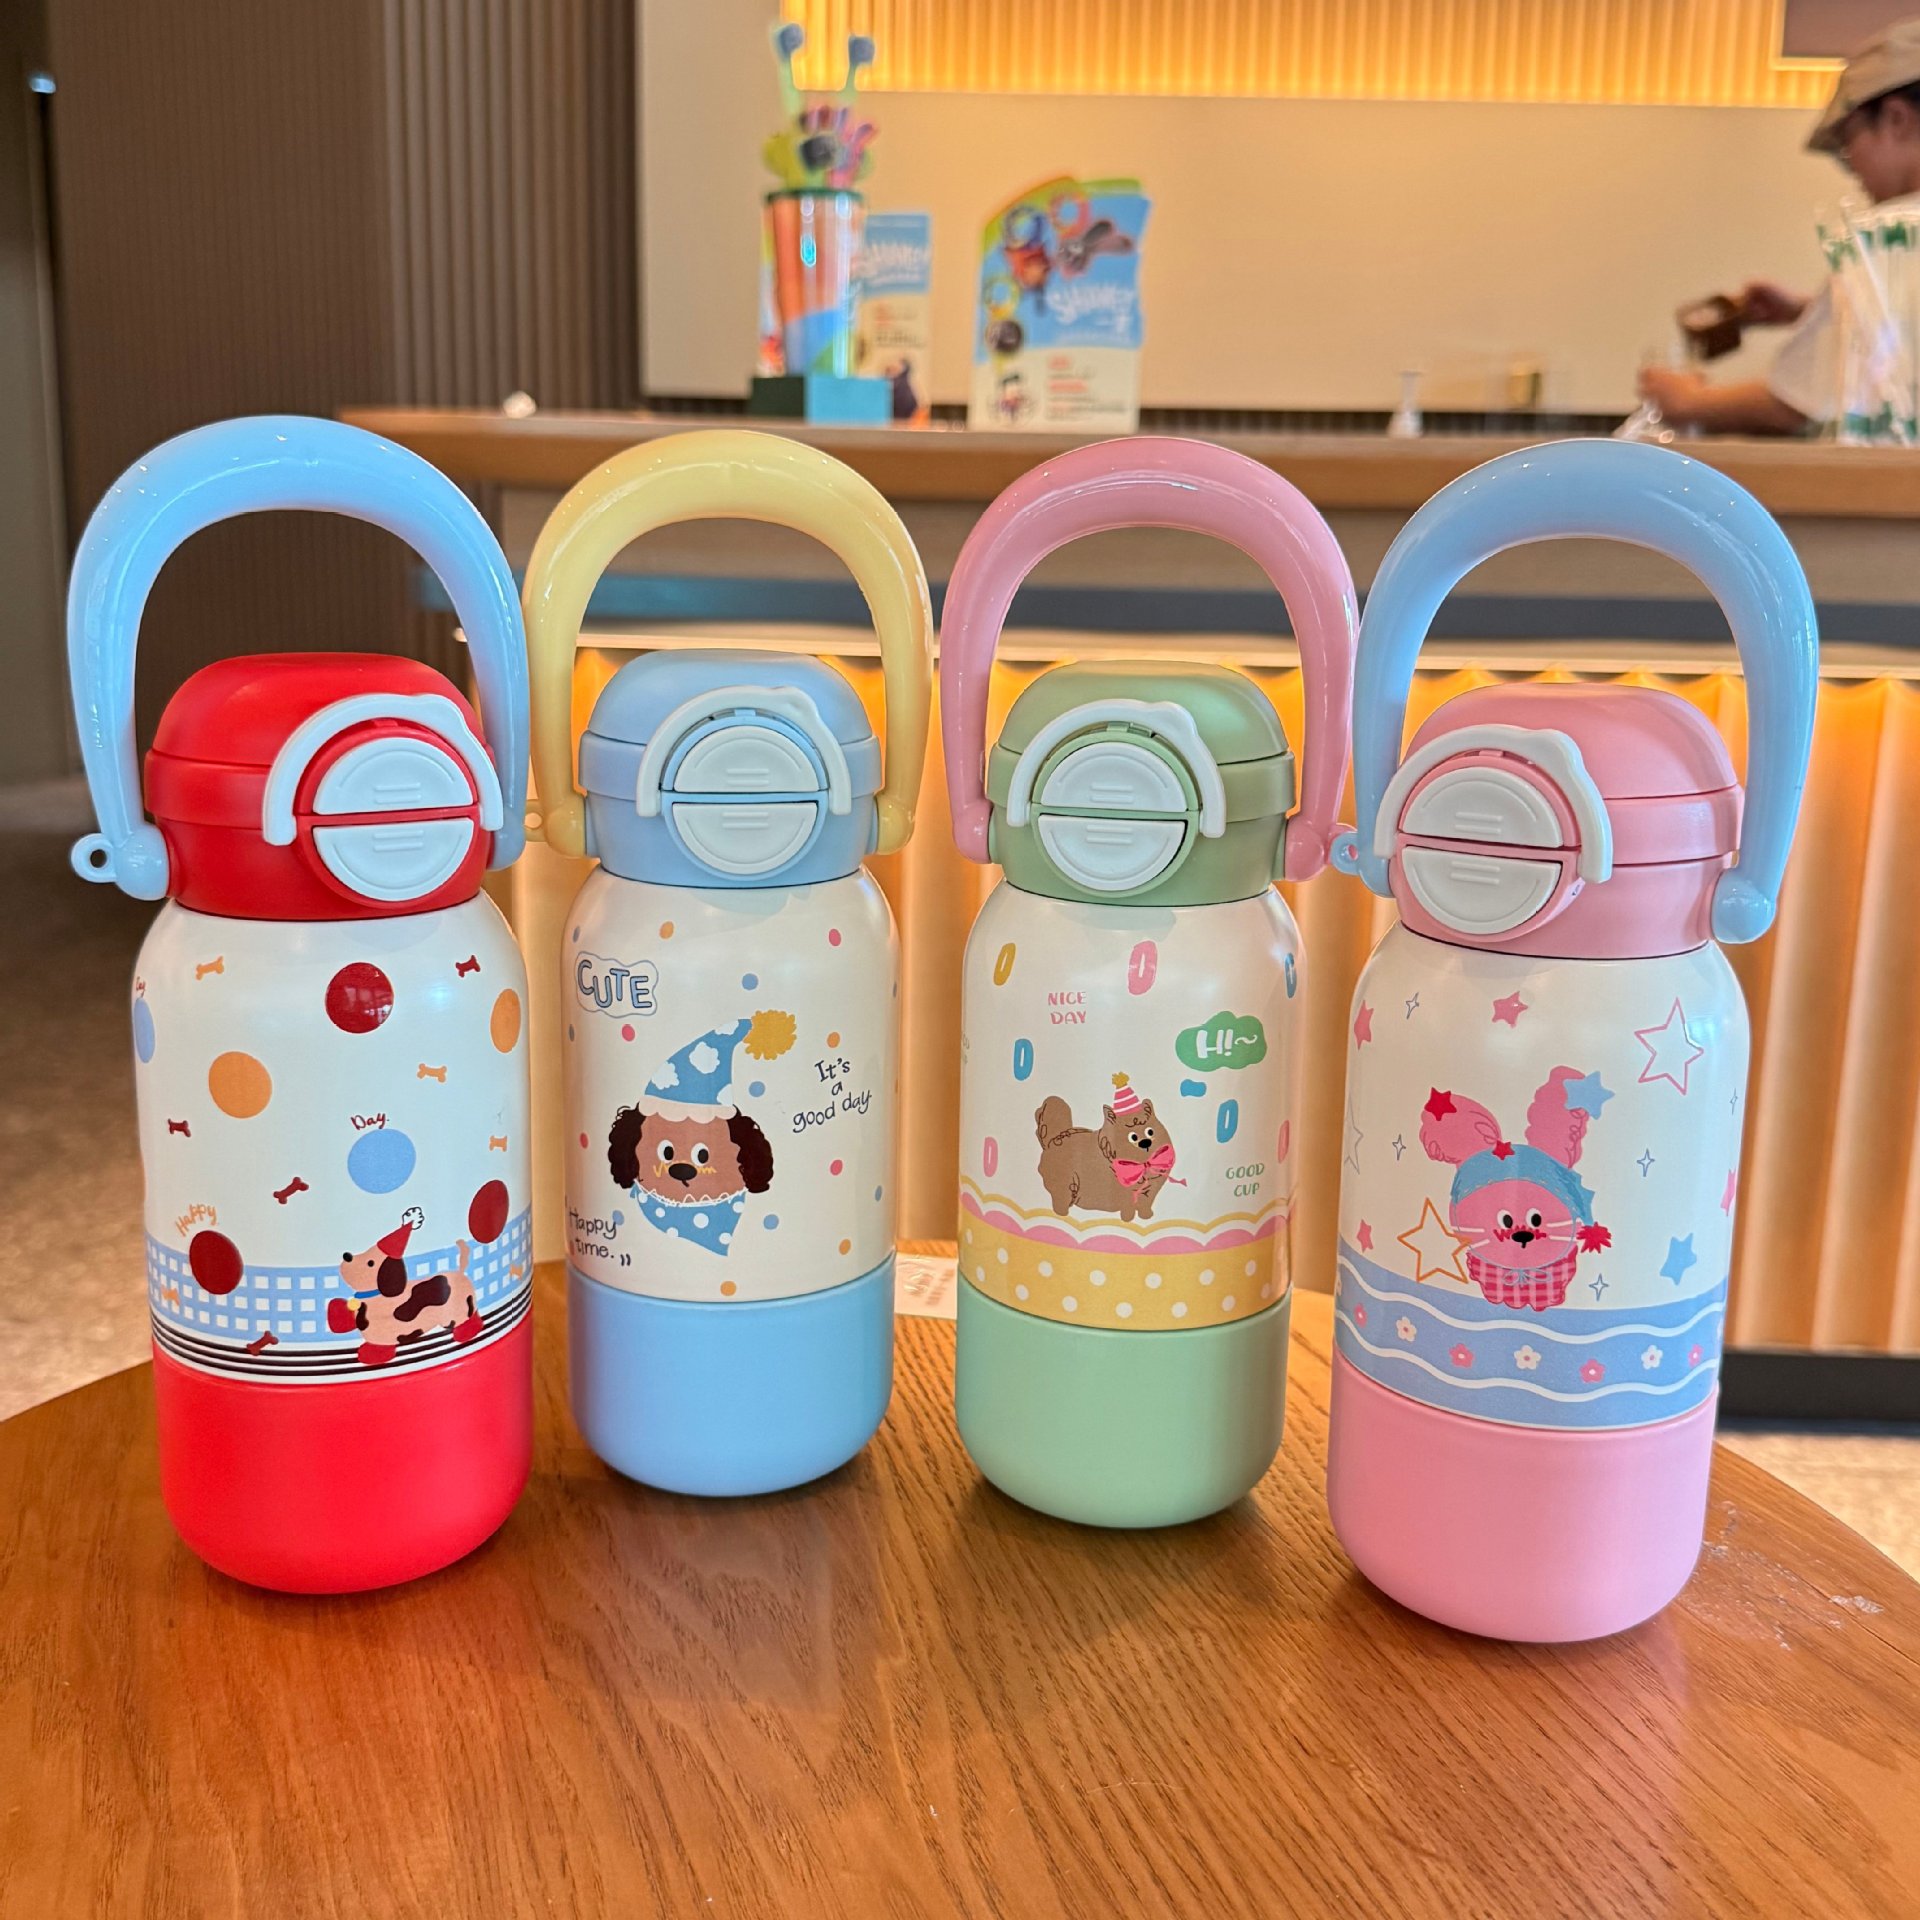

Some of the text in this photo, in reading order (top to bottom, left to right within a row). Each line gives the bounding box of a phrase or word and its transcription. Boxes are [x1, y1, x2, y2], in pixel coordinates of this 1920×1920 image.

[577, 959, 653, 1009] CUTE
[1048, 991, 1087, 1006] NICE
[1050, 1010, 1087, 1025] DAY
[814, 1057, 851, 1083] It's
[831, 1080, 843, 1096] a
[792, 1100, 836, 1134] good
[1225, 1162, 1265, 1180] GOOD
[1233, 1182, 1260, 1198] CUP
[569, 1206, 618, 1240] Happy
